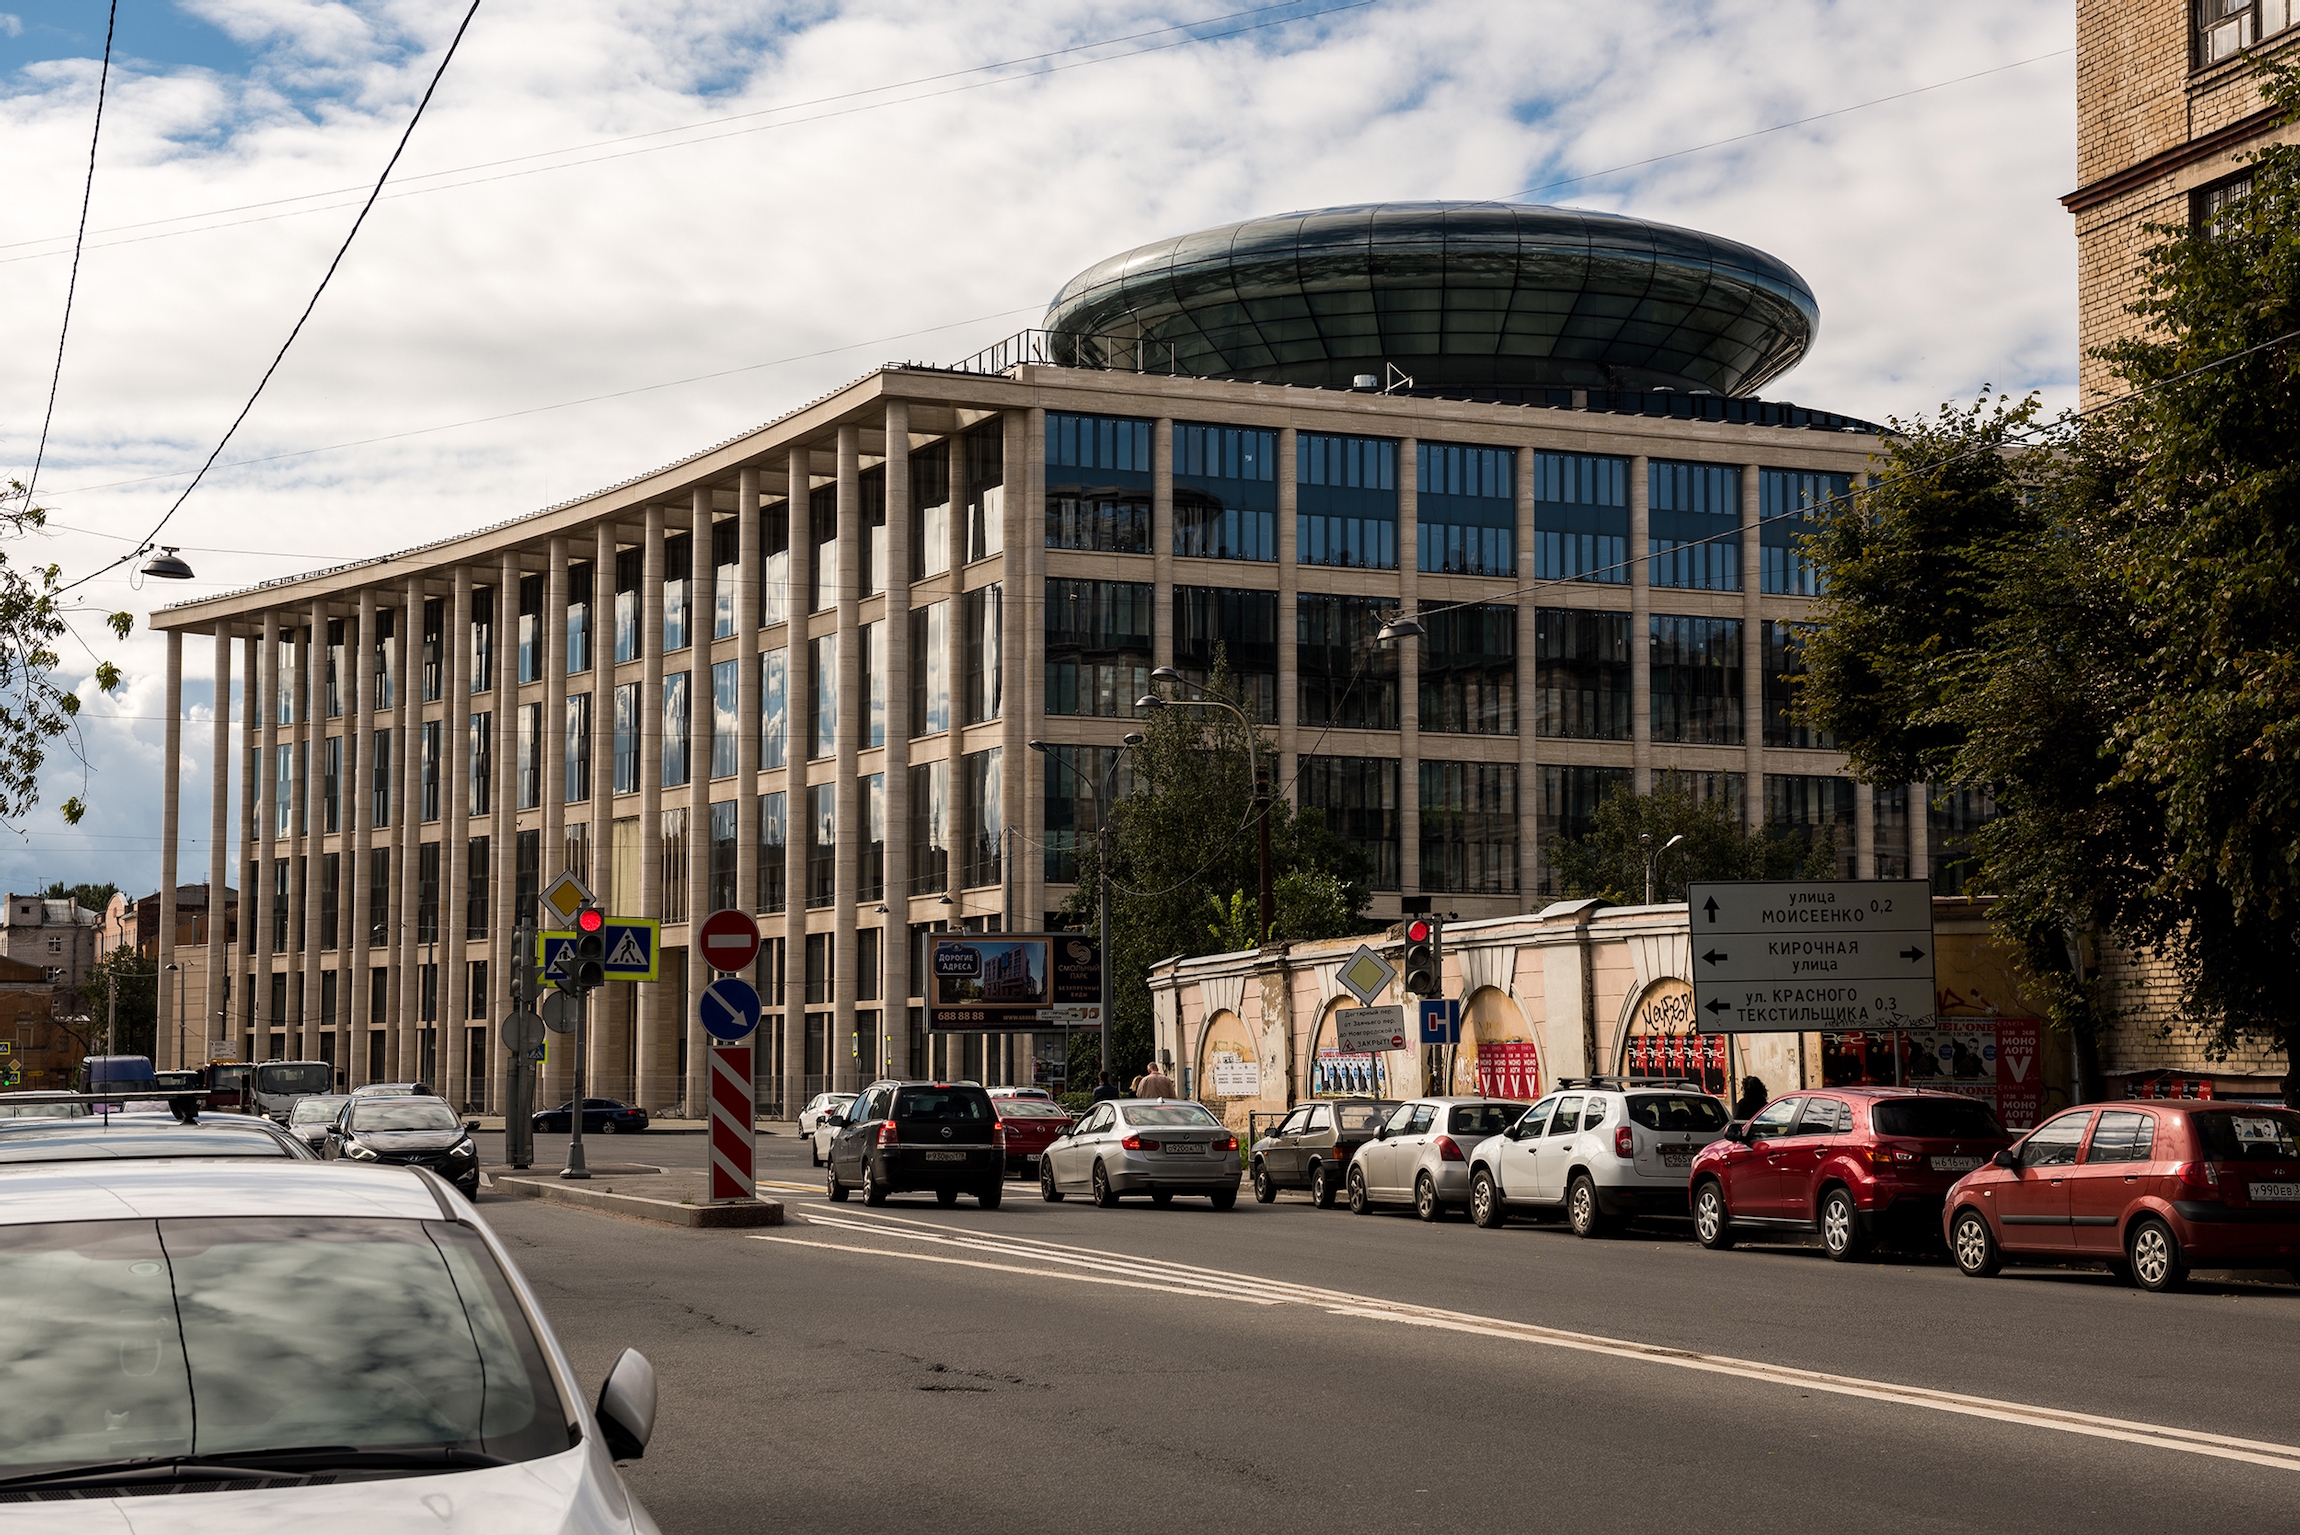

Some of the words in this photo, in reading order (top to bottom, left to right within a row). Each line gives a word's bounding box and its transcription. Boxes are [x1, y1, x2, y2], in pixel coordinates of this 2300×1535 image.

[1789, 892, 1836, 906] улица
[1870, 899, 1893, 914] 0,2
[1768, 940, 1859, 955] КИРОЧНАЯ
[938, 953, 974, 962] ДОРОГИЕ
[942, 962, 973, 971] АДРЕСА
[1058, 963, 1100, 972] СМОЛЬНЫЙ
[1792, 960, 1838, 974] улица
[1069, 972, 1088, 980] ПАРК
[1745, 991, 1767, 1006] ул.
[1772, 988, 1857, 1003] КРАСНОГО
[1874, 997, 1897, 1012] 0,3
[937, 1011, 957, 1021] 688
[957, 1011, 971, 1021] 88
[971, 1011, 985, 1021] 88
[1736, 1007, 1869, 1023] ТЕКСТИЛЬЩИКА
[1357, 1038, 1390, 1048] ЗАКРЫТ!
[2002, 1037, 2036, 1046] МОНО
[2004, 1046, 2034, 1055] ЛОГИ
[2004, 1055, 2032, 1083] V
[2002, 1101, 2037, 1110] МОНО
[2004, 1110, 2034, 1119] ЛОГИ
